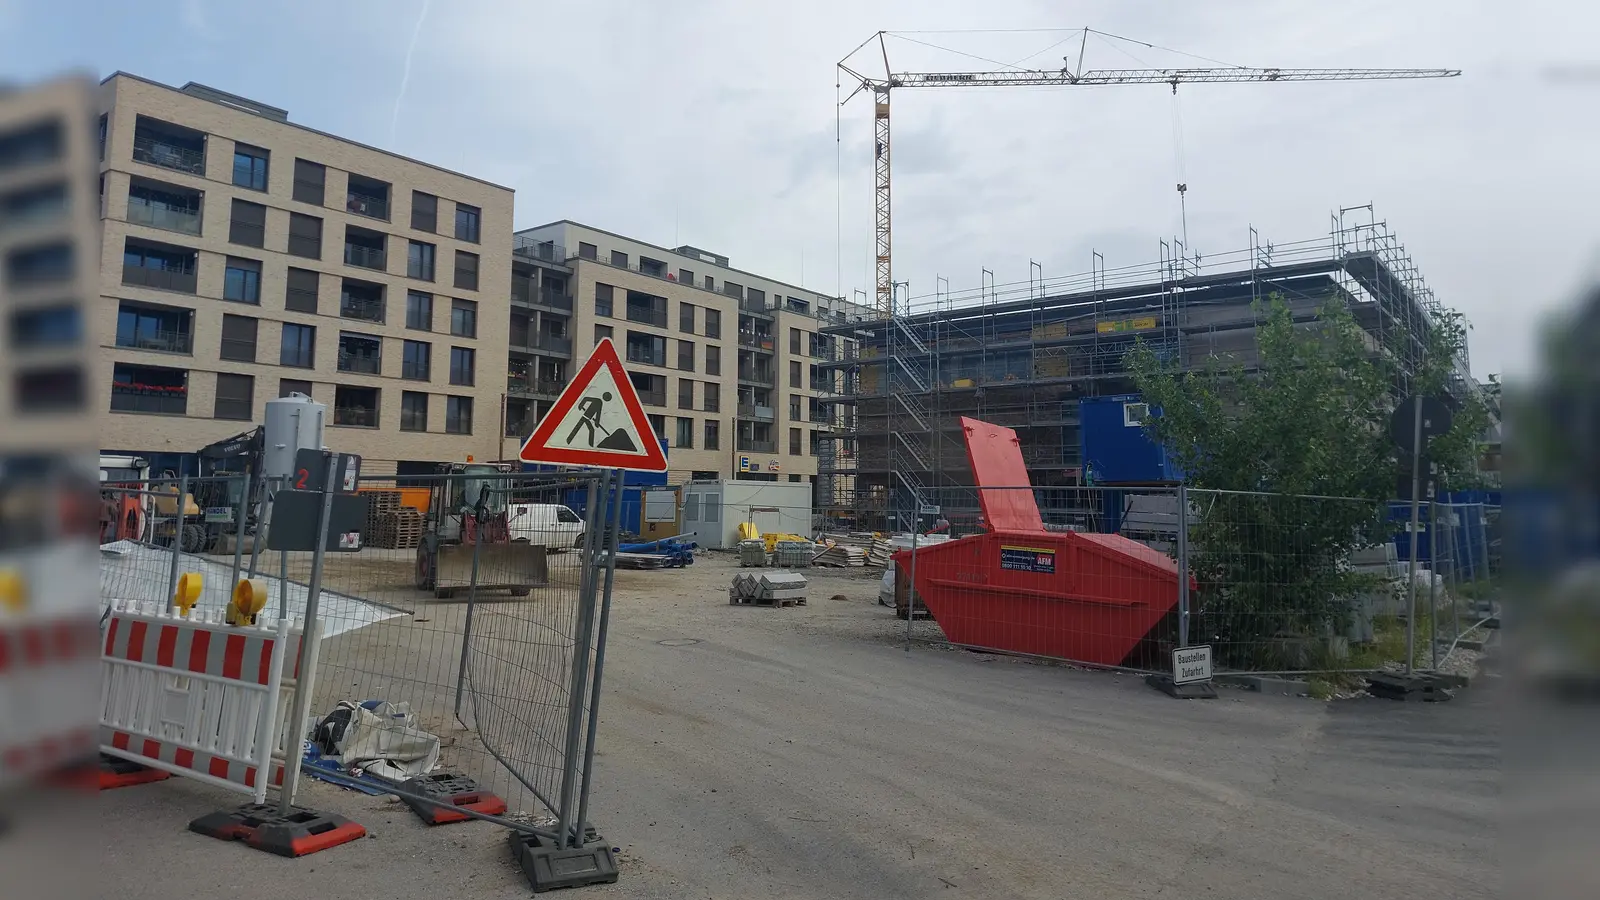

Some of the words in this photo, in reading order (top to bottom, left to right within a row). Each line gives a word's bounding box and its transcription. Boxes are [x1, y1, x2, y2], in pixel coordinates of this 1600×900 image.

[741, 457, 749, 468] E
[296, 468, 309, 489] 2
[1037, 557, 1052, 566] AFM
[1177, 652, 1206, 664] Baustellen
